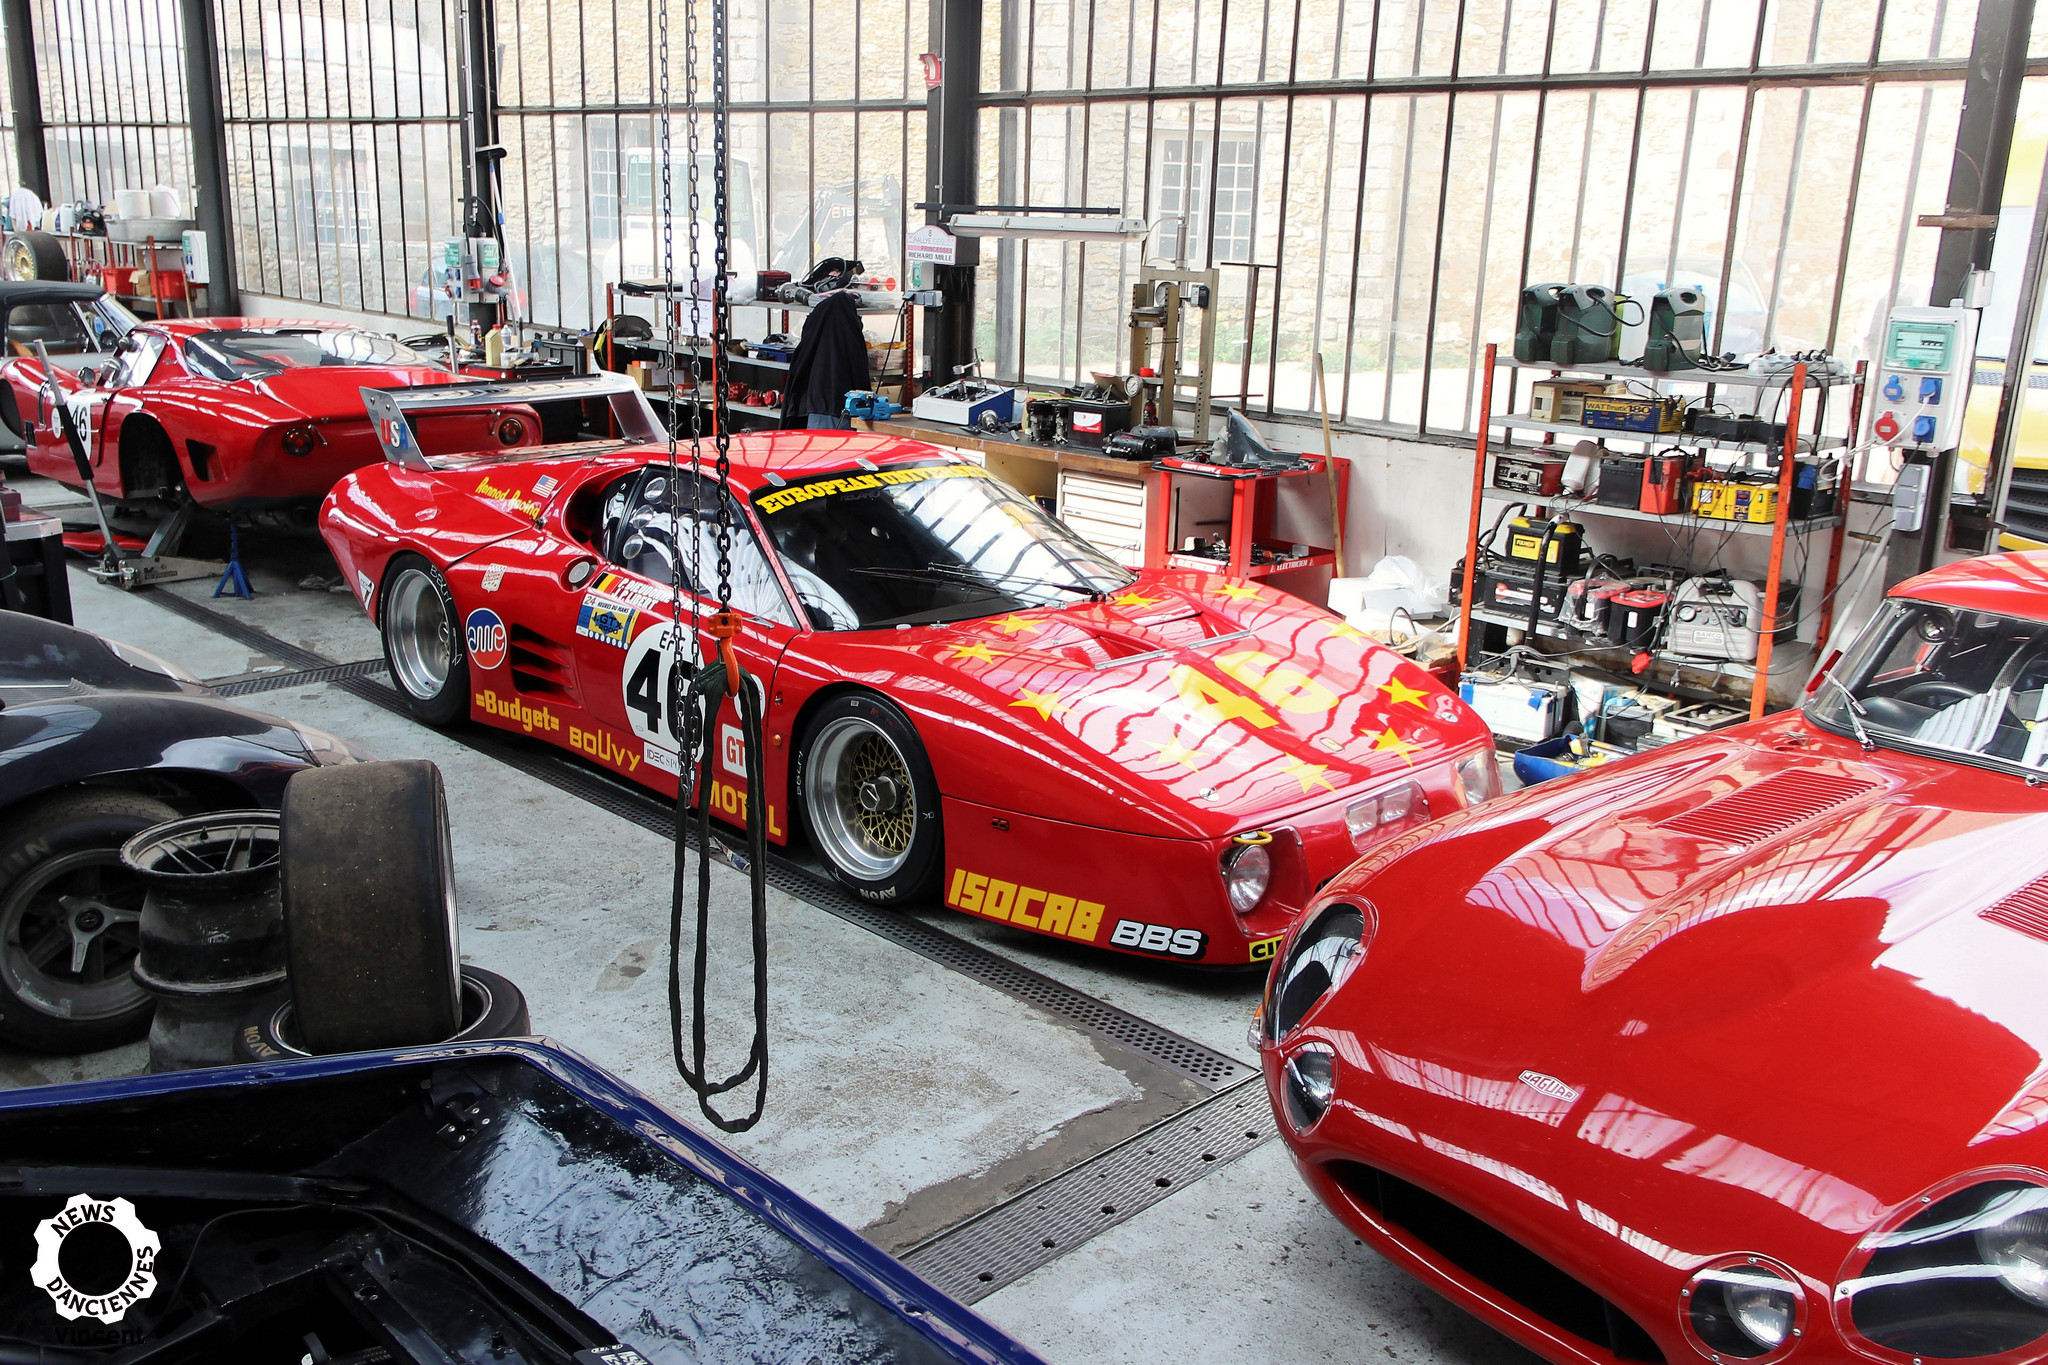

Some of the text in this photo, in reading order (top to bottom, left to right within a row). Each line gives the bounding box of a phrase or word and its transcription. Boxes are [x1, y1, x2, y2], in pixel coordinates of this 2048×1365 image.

[913, 236, 931, 245] RALLYE
[921, 245, 952, 254] PRINCESSES
[908, 251, 952, 262] RICHARD MILLE
[1627, 405, 1651, 413] 180
[380, 418, 409, 450] USA
[475, 476, 541, 519] Rennod Racing
[755, 473, 883, 514] EUROPEAN
[584, 596, 597, 606] 24
[597, 601, 612, 610] HEURES
[617, 606, 630, 614] MANS
[1168, 651, 1340, 730] 46
[646, 748, 665, 765] IDEC
[710, 779, 782, 837] MOTL
[860, 886, 897, 900] AVON
[948, 868, 1106, 942] ISOCAB
[1110, 918, 1203, 957] BBS
[1252, 940, 1281, 958] CI
[243, 1025, 281, 1057] AVON
[1523, 1074, 1574, 1099] JAGUAR
